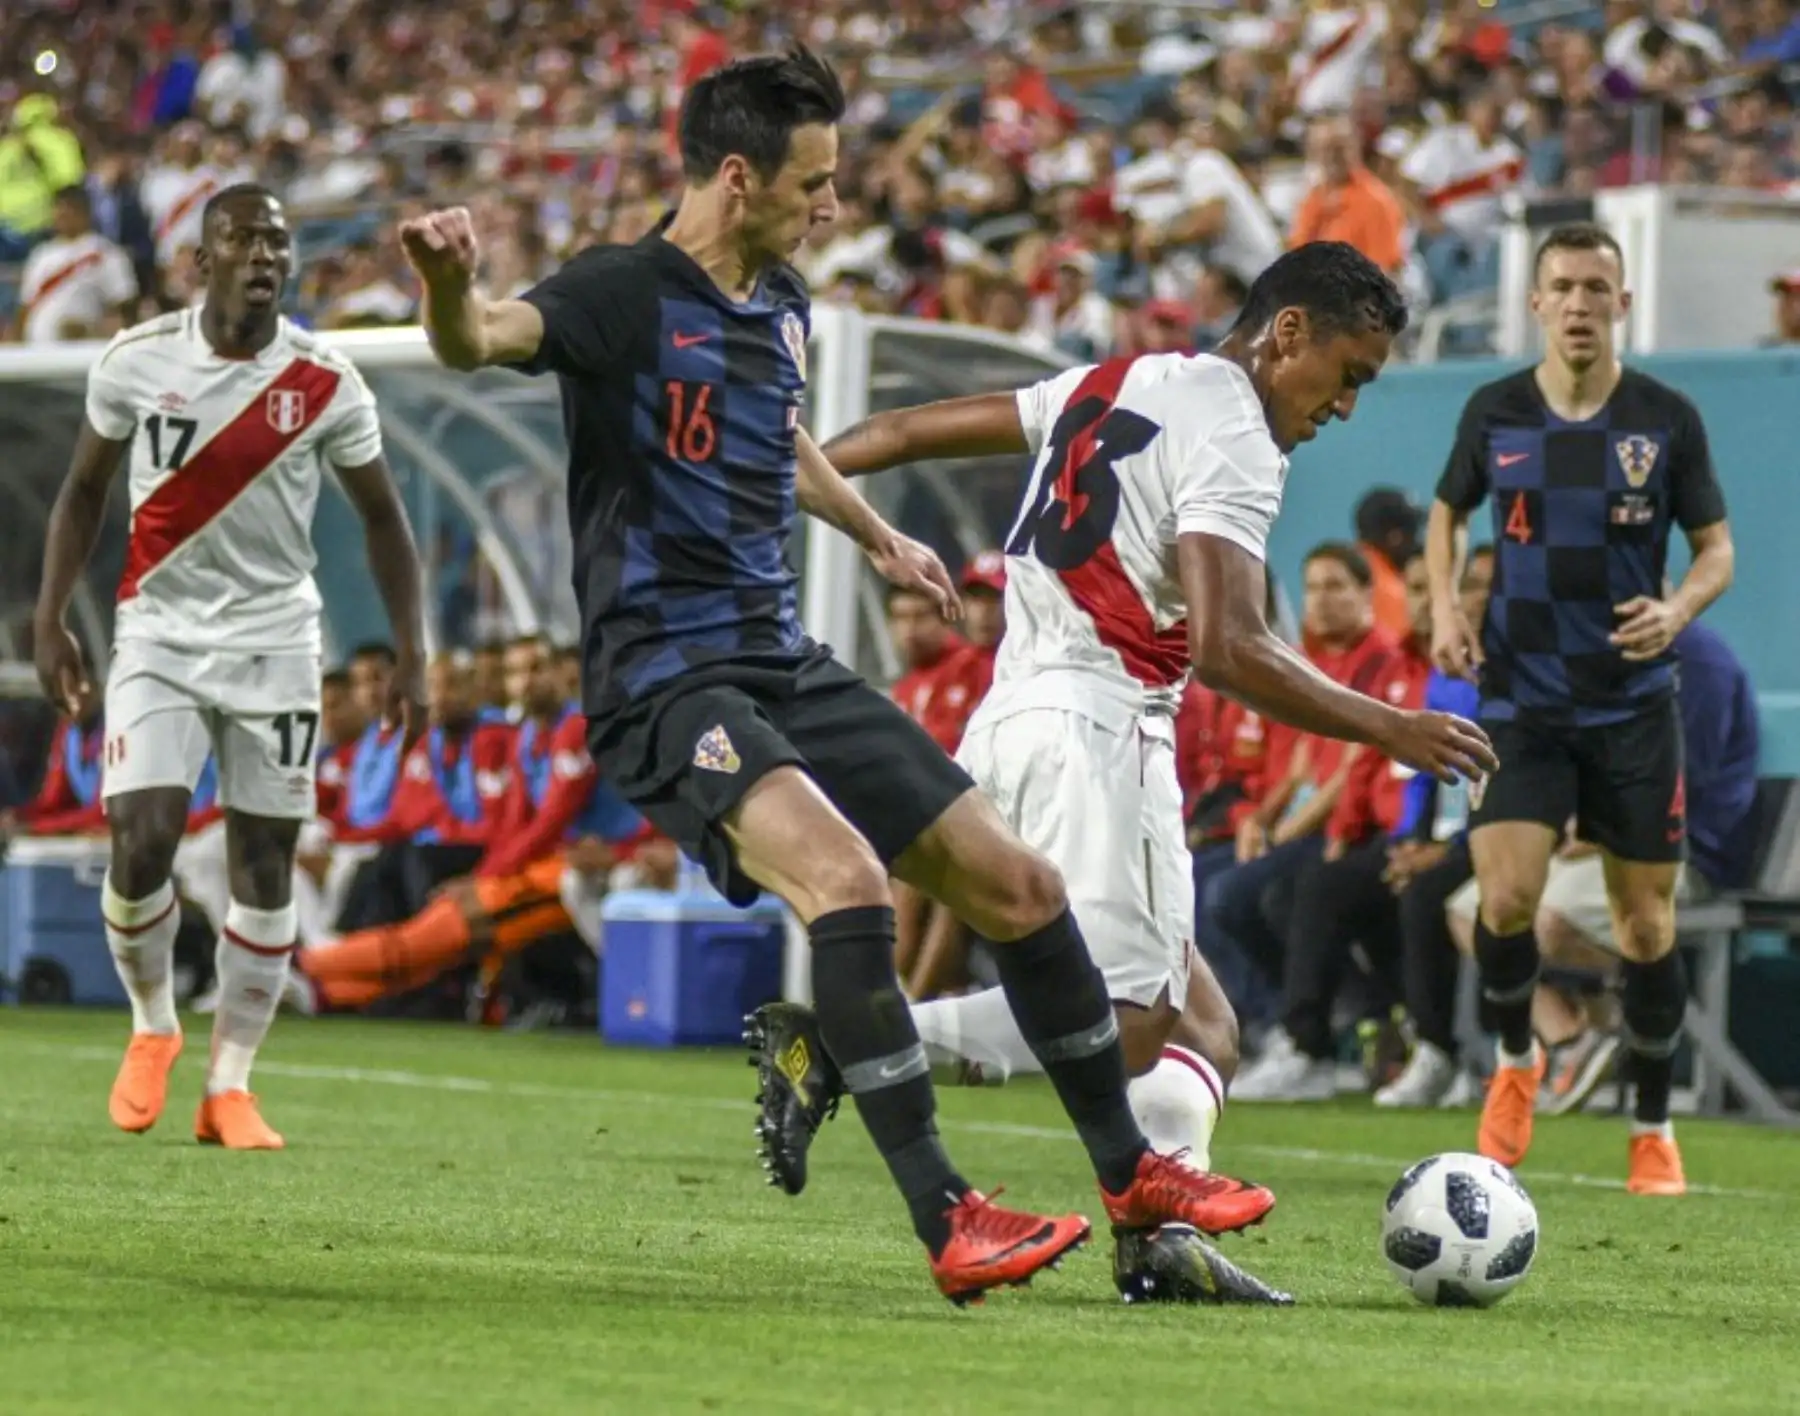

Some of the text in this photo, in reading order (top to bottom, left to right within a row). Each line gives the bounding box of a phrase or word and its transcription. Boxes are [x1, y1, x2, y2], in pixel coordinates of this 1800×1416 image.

[144, 414, 198, 470] 17
[666, 380, 715, 462] 16
[1506, 489, 1534, 545] 4
[272, 713, 319, 767] 17
